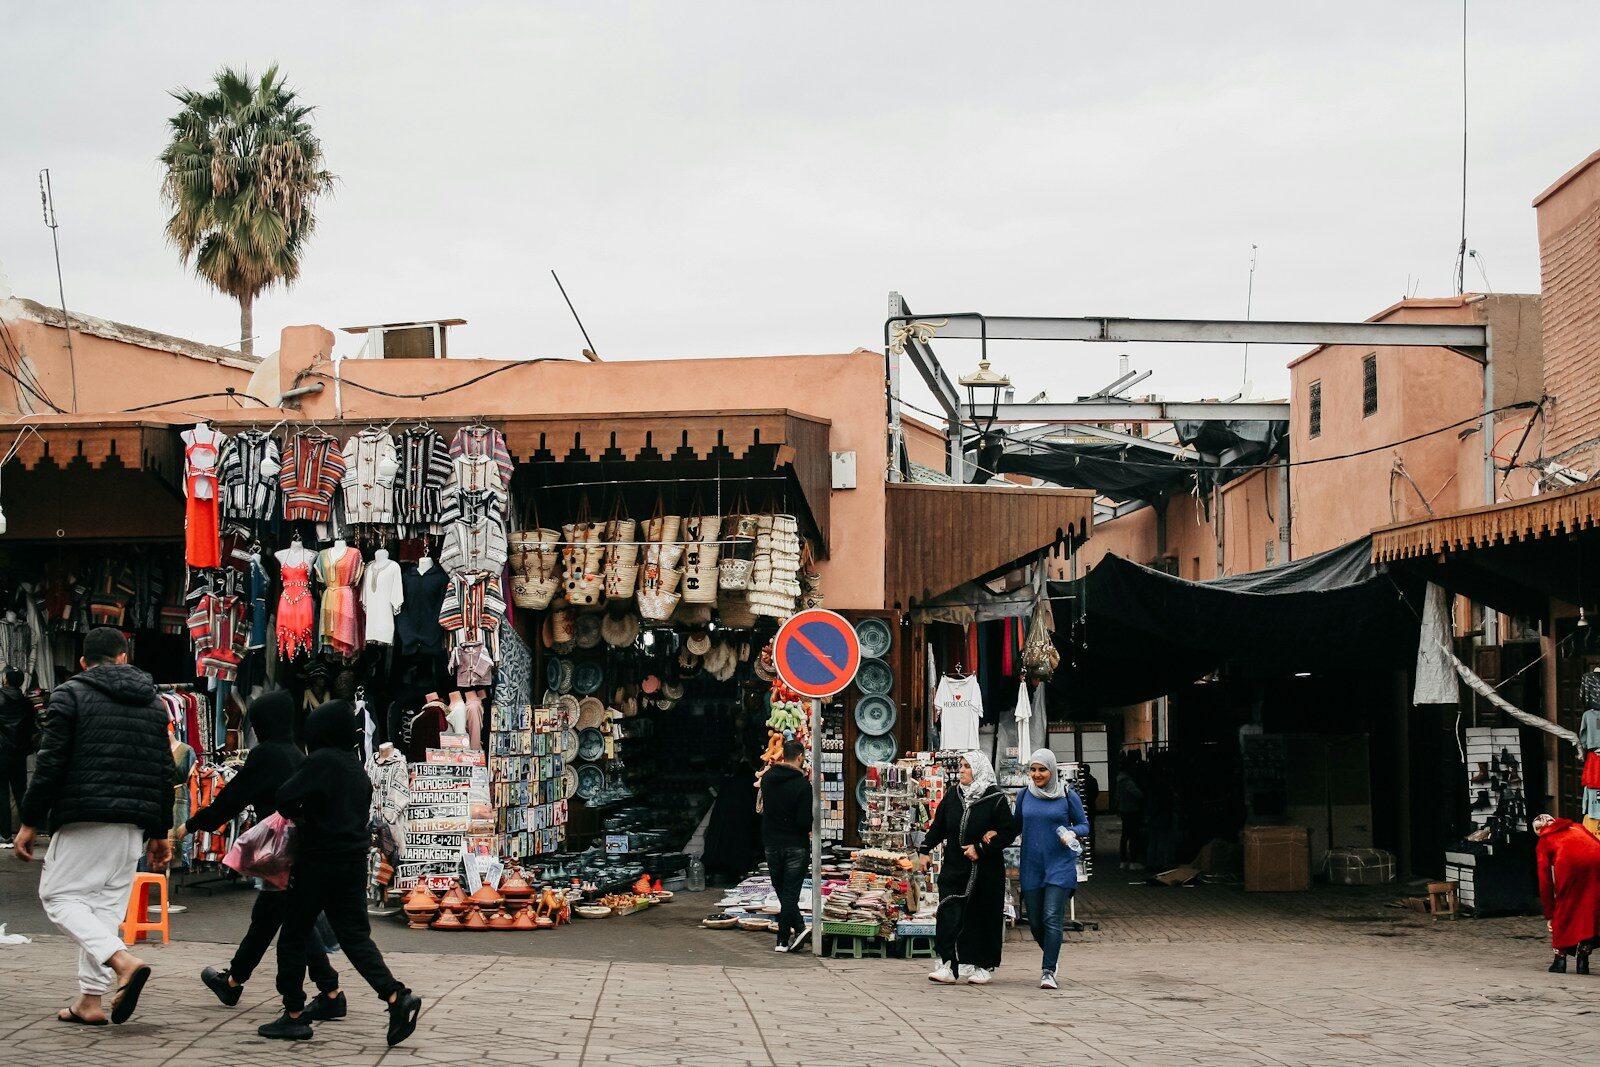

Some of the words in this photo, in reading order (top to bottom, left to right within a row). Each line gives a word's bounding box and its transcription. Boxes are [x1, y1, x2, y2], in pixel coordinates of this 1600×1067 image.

[419, 765, 437, 776] 1960
[416, 779, 453, 791] MOROCCO
[411, 792, 460, 803] MARRAKECH
[456, 805, 467, 816] 26
[406, 834, 431, 845] 31548
[446, 836, 460, 846] 210
